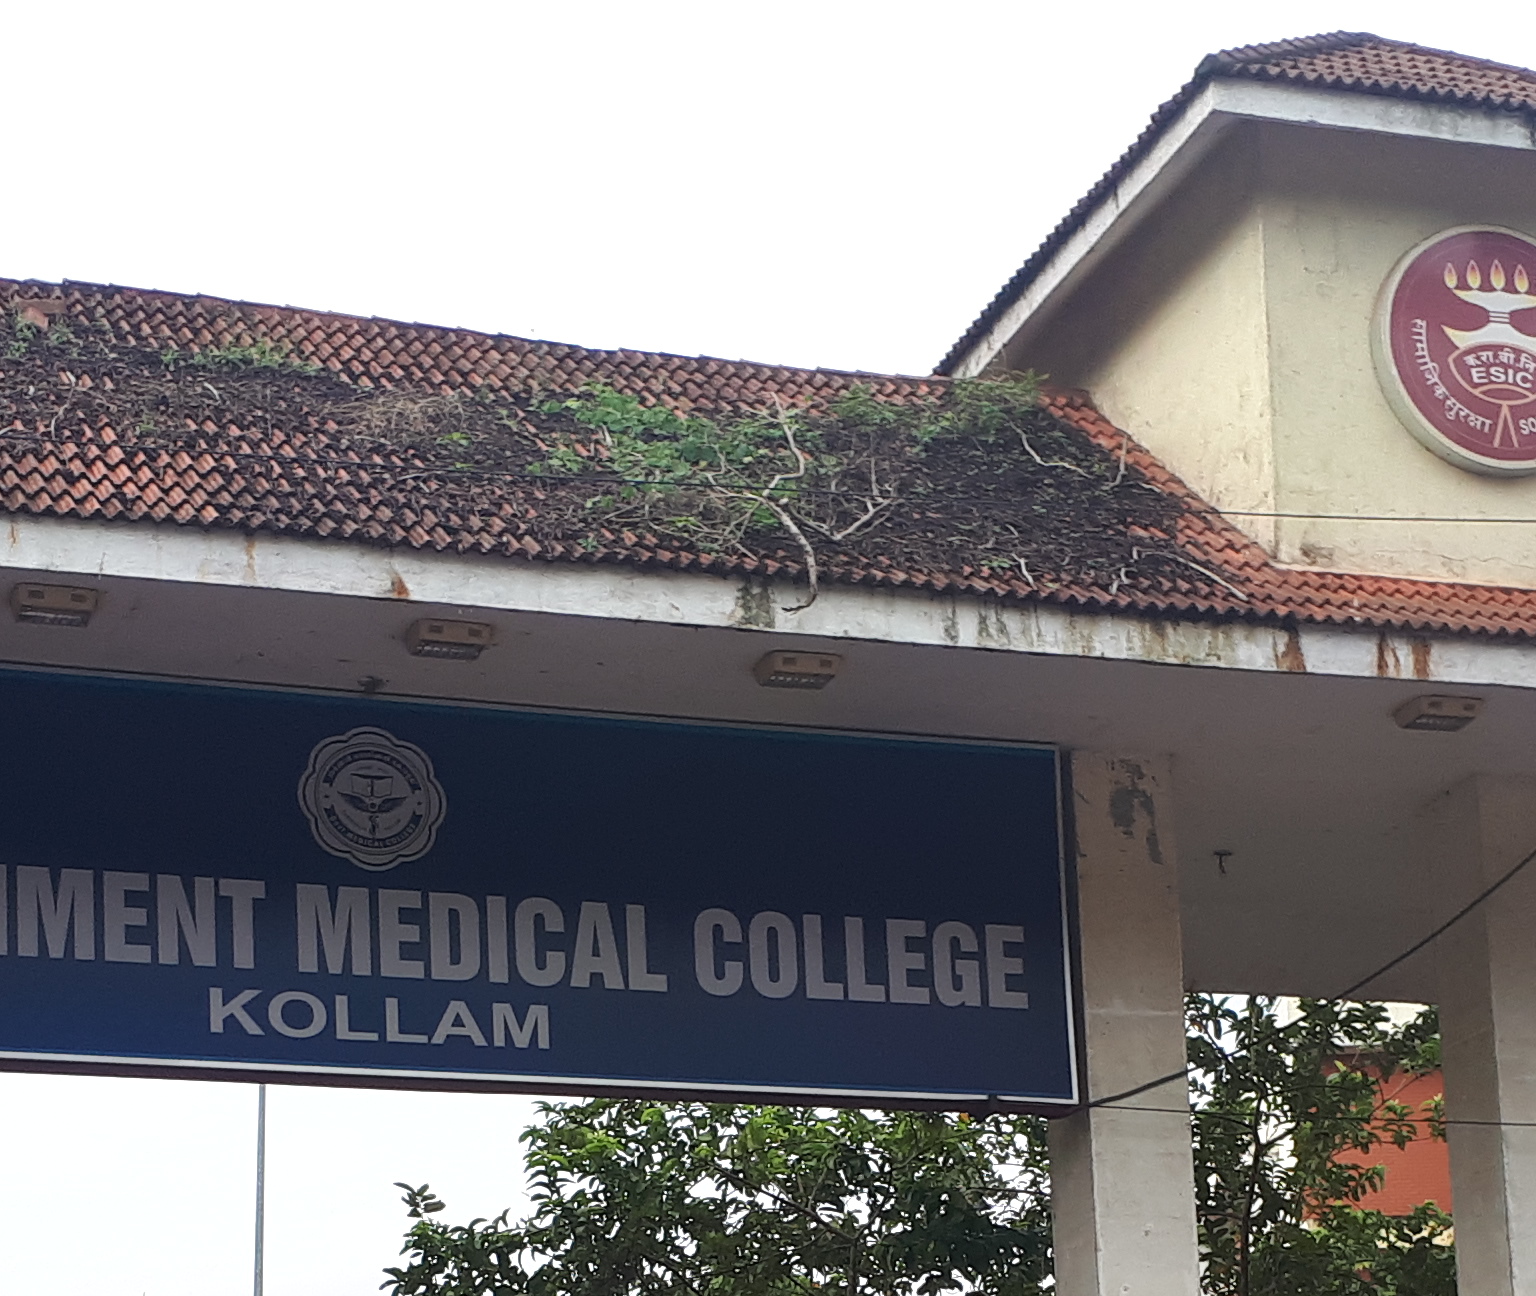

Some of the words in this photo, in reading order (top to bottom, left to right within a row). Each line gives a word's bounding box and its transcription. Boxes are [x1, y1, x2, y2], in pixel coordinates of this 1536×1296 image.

[1471, 367, 1535, 389] ESIC
[296, 884, 668, 994] MEDICAL
[692, 906, 1031, 1010] COLLEGE
[208, 988, 553, 1051] KOLLAM
